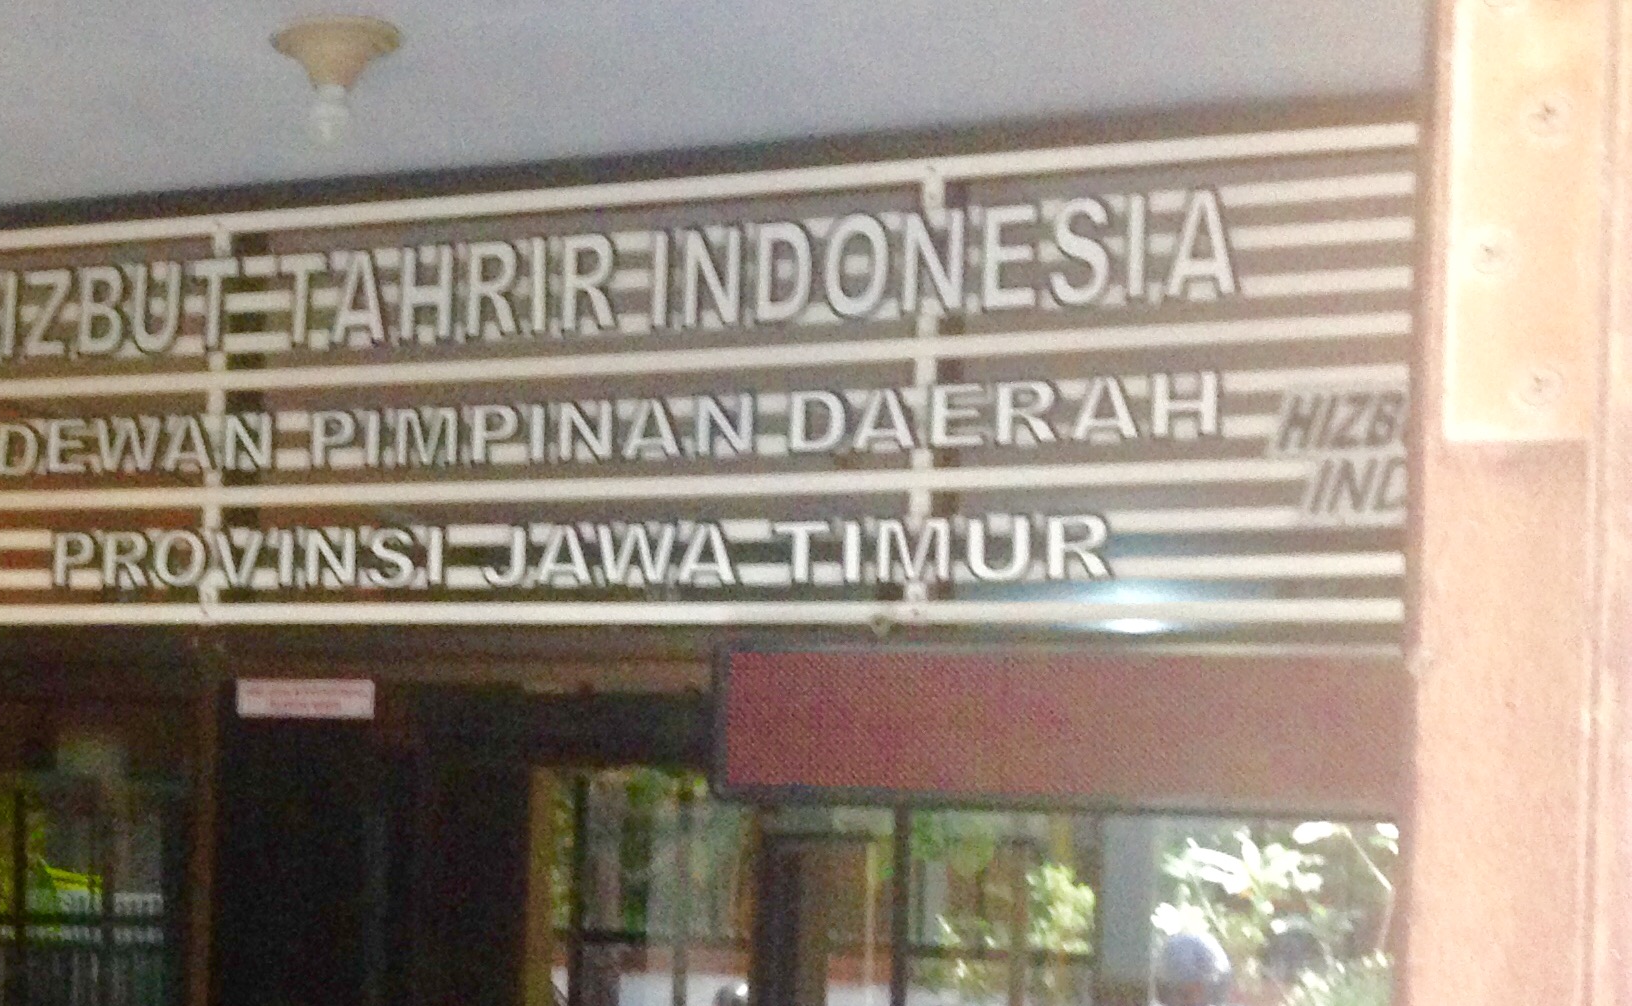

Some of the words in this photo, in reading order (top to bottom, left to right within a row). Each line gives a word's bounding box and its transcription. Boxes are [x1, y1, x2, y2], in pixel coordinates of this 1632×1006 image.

[277, 230, 619, 347] TAHRIR
[649, 186, 1240, 333] INDONESIA
[309, 397, 757, 471] PIMPINAN
[785, 369, 1222, 456] DAERAH
[52, 525, 448, 590] PROVINSI
[481, 521, 741, 588] JAWA
[771, 513, 1114, 584] TIMUR
